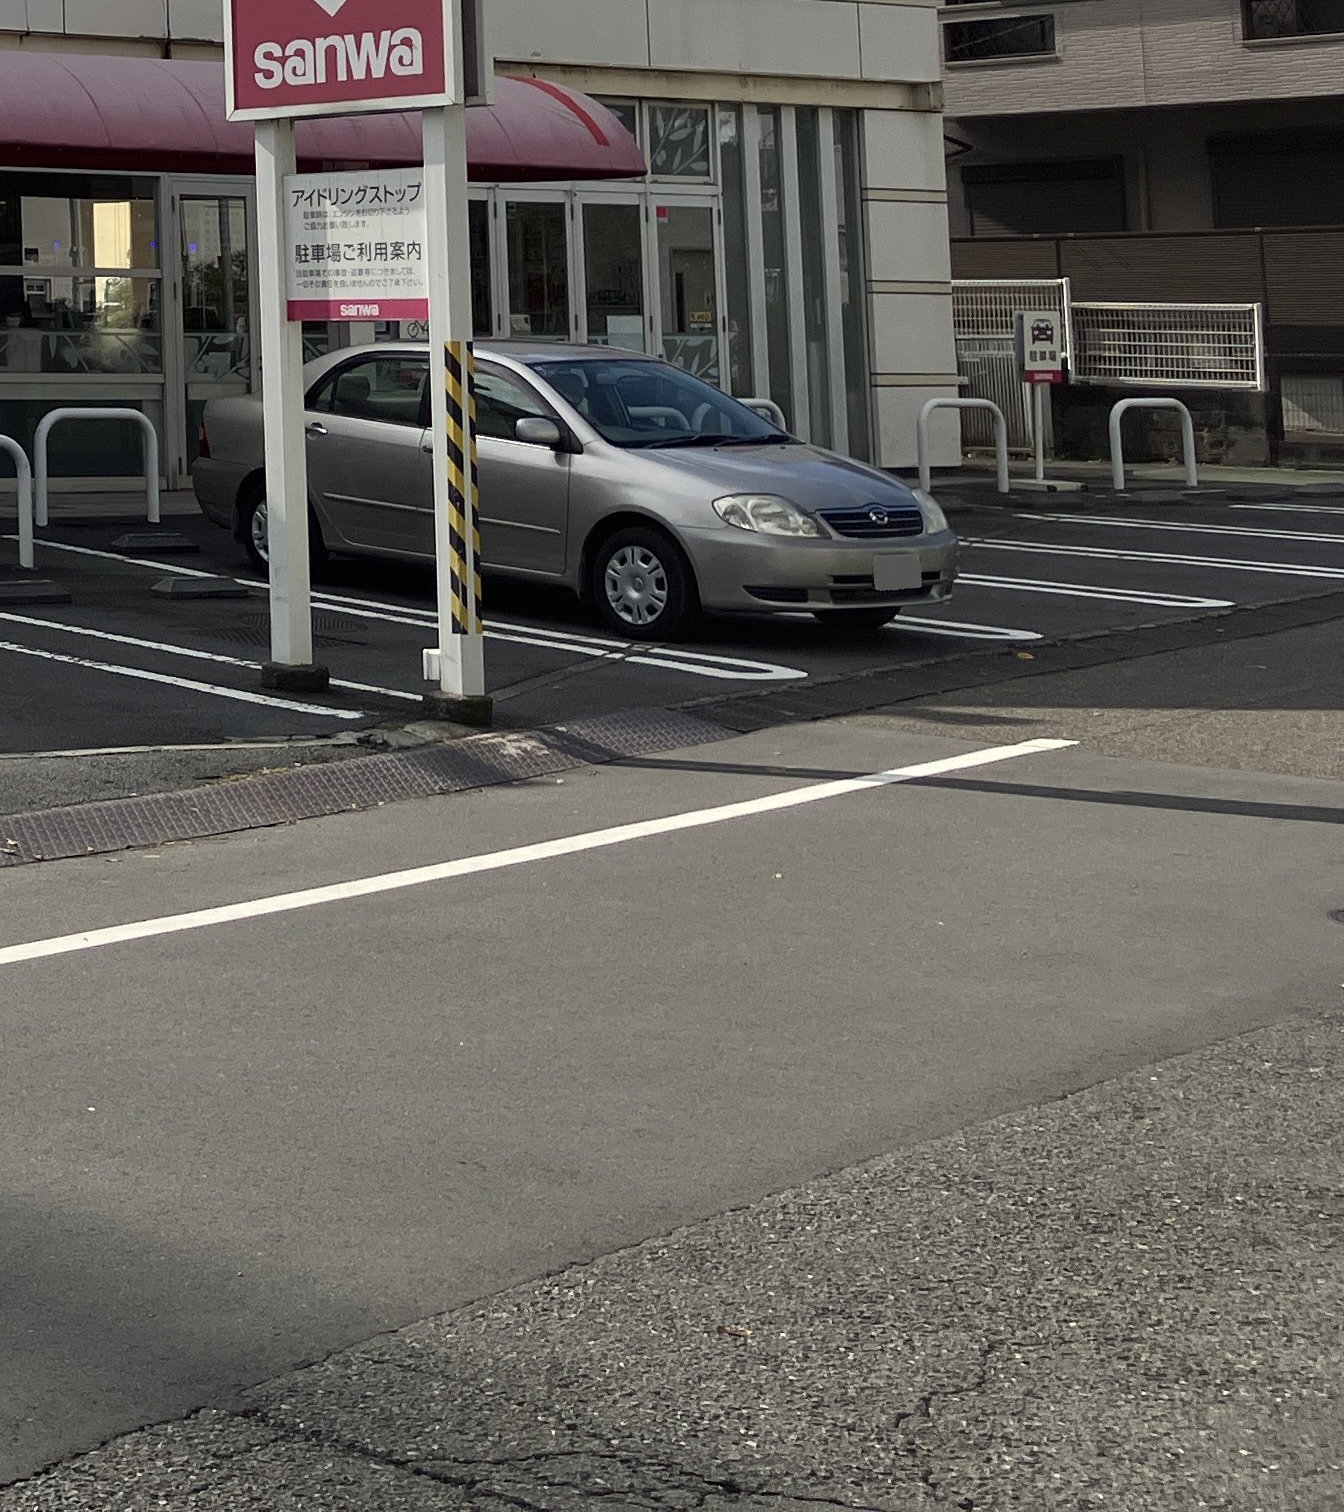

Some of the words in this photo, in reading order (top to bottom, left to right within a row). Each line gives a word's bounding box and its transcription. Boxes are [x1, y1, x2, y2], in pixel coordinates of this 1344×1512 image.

[253, 26, 424, 89] sanwa
[291, 182, 422, 208] アイドリングストップ
[295, 240, 422, 264] 駐車場ご利用案内
[339, 303, 380, 316] sanwa
